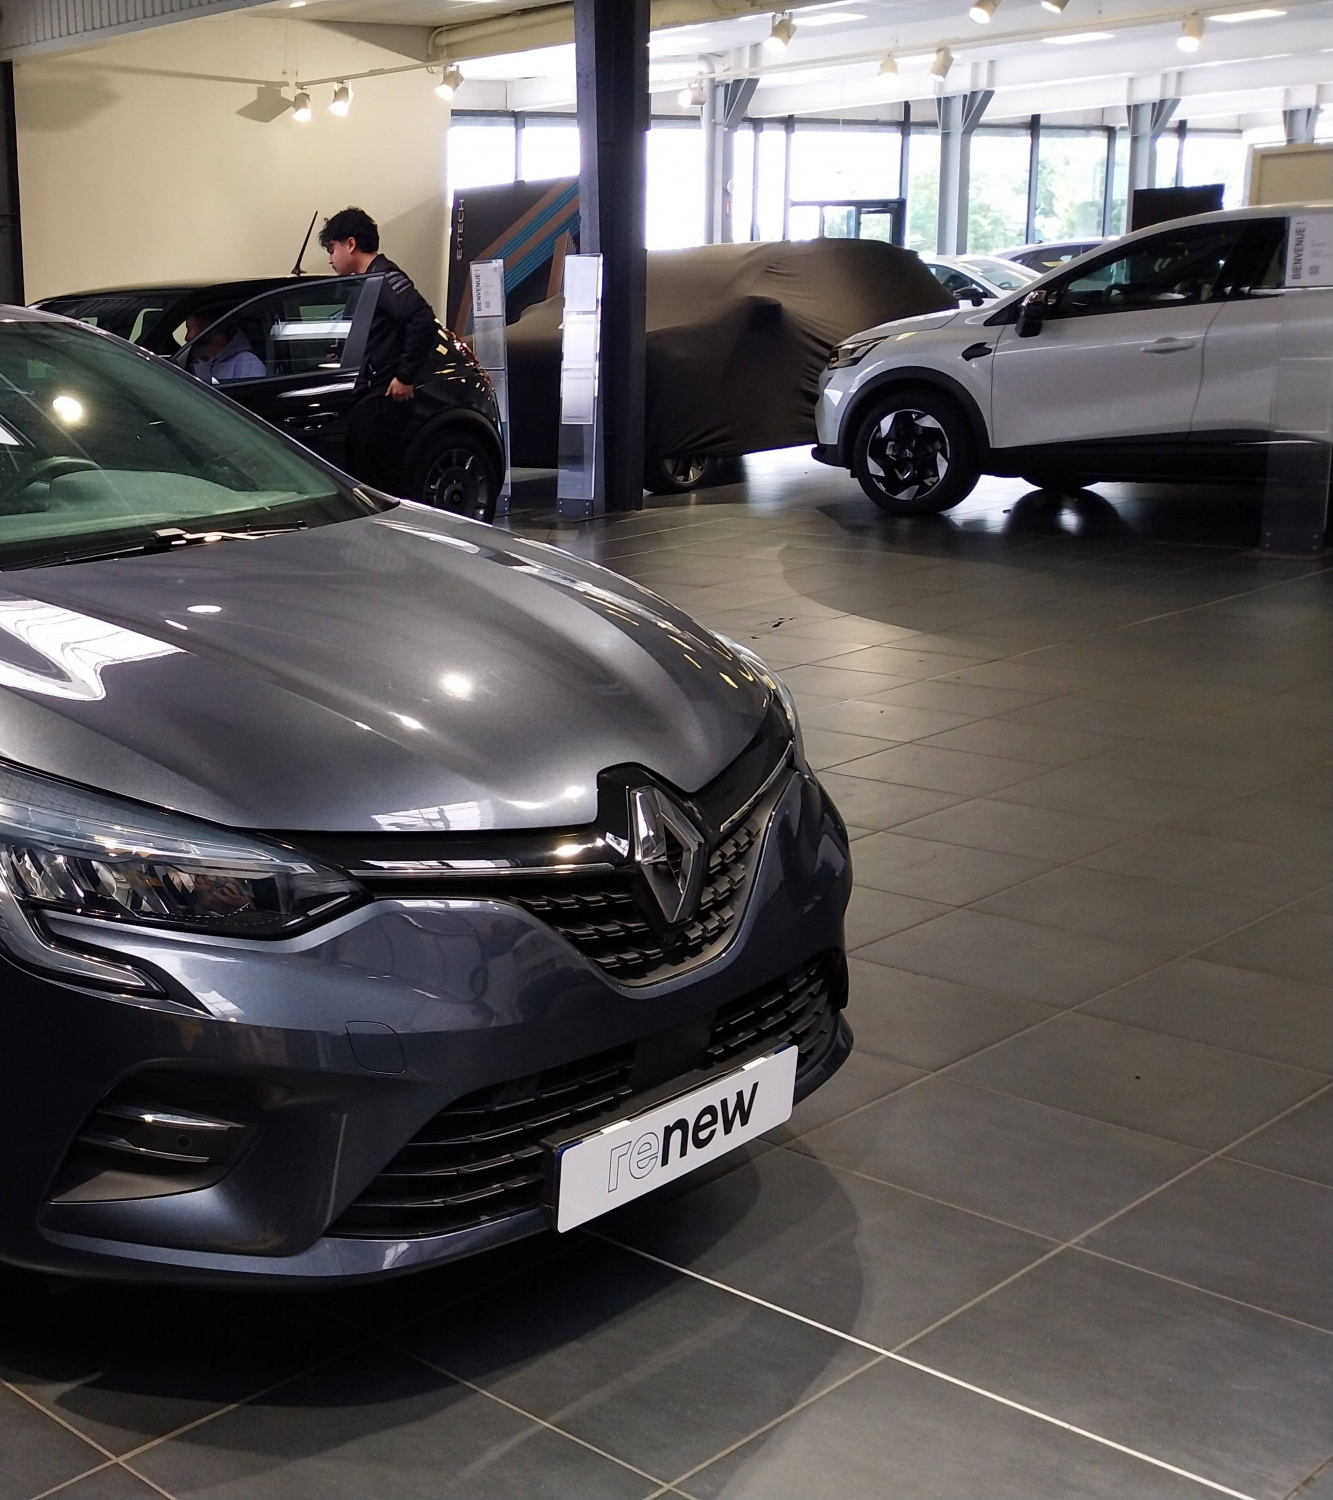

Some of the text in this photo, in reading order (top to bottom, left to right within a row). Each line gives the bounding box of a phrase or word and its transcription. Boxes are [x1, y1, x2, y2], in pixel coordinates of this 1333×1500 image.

[456, 199, 465, 261] E-TECH
[1291, 227, 1306, 280] BIENVENUE
[475, 273, 483, 312] BIENVENUE
[608, 1081, 759, 1193] renew
